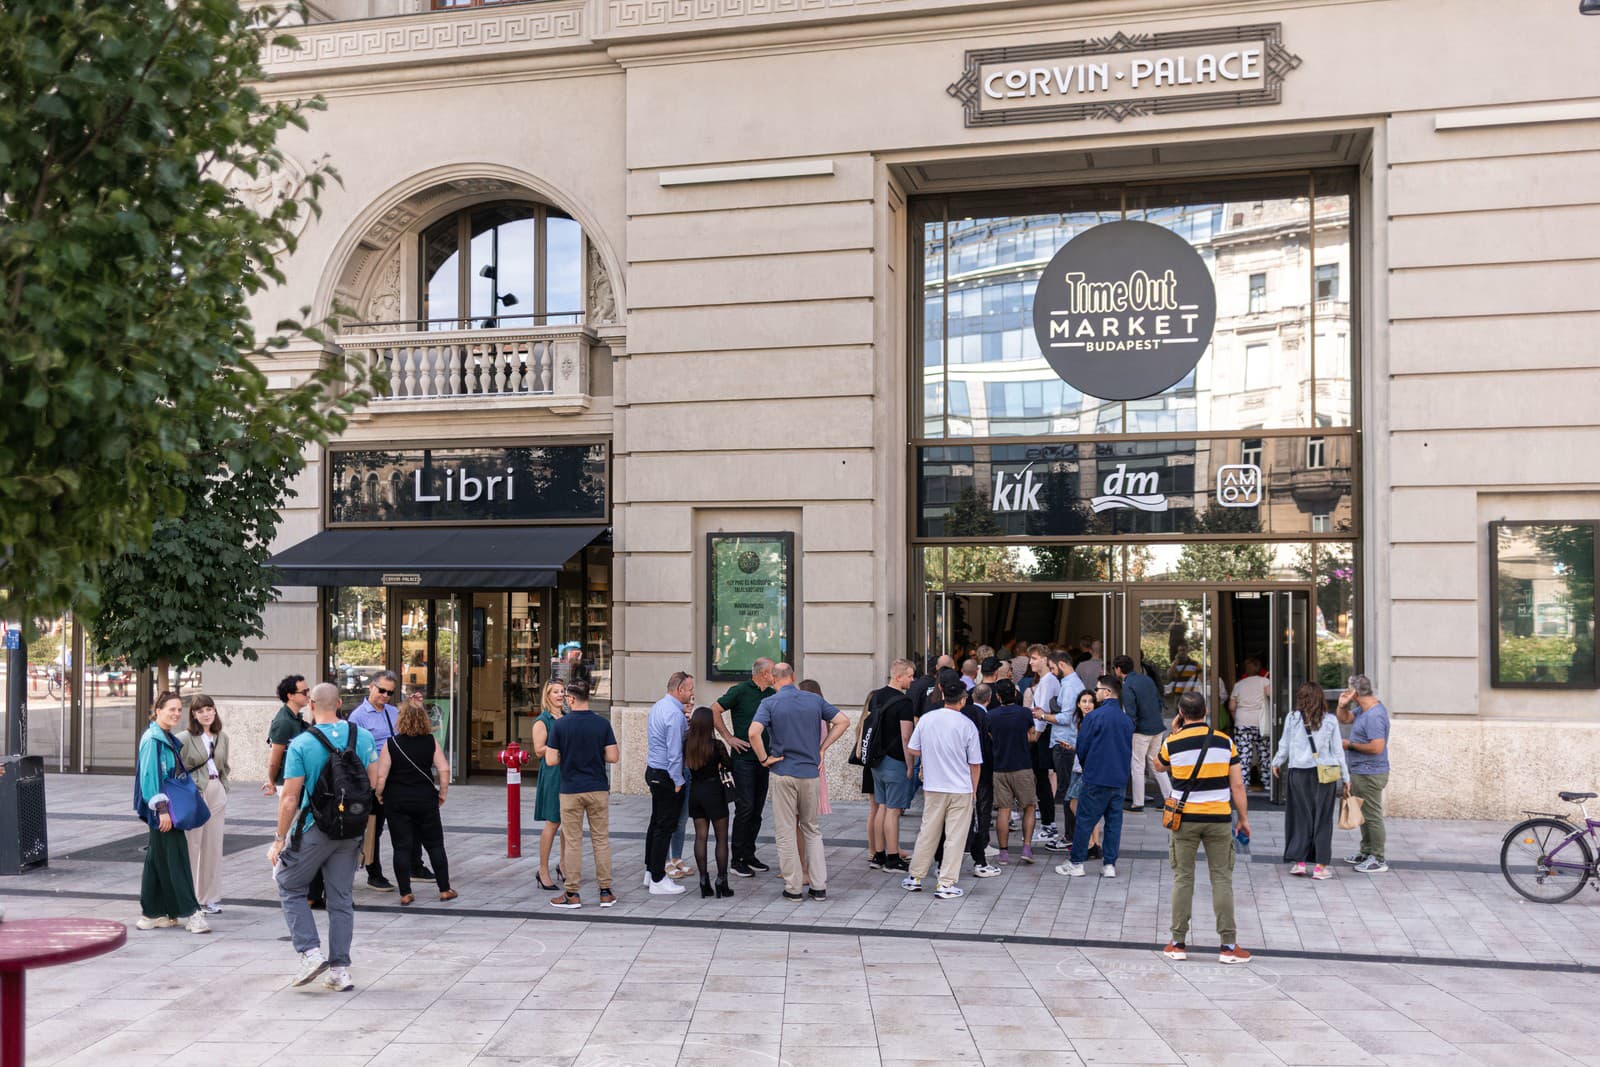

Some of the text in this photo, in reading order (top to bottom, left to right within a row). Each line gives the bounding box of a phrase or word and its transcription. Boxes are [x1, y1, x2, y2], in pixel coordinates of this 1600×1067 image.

[984, 48, 1261, 99] CORVIN PALACE
[1065, 269, 1178, 314] Time Out
[1049, 313, 1199, 339] MARKET
[1086, 338, 1161, 352] BUDAPEST
[414, 467, 515, 502] Libri
[1103, 463, 1160, 496] dm
[861, 727, 873, 765] adidas
